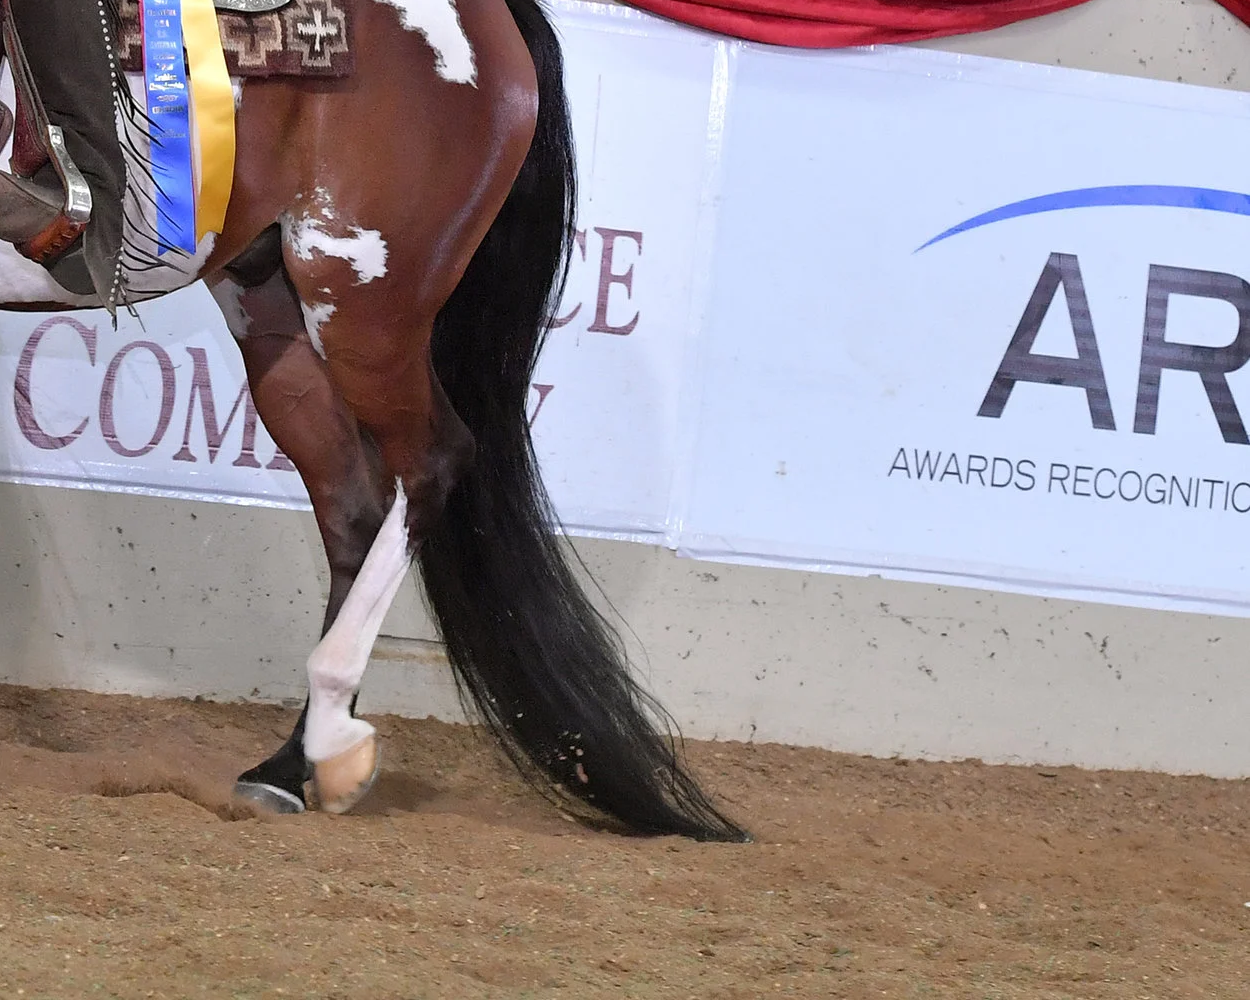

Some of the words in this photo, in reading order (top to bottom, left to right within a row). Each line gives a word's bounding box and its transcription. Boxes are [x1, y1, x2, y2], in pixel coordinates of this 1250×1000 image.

[976, 251, 1250, 446] AR
[888, 447, 1036, 491] AWARDS
[1048, 462, 1250, 513] RECOGNITIO
